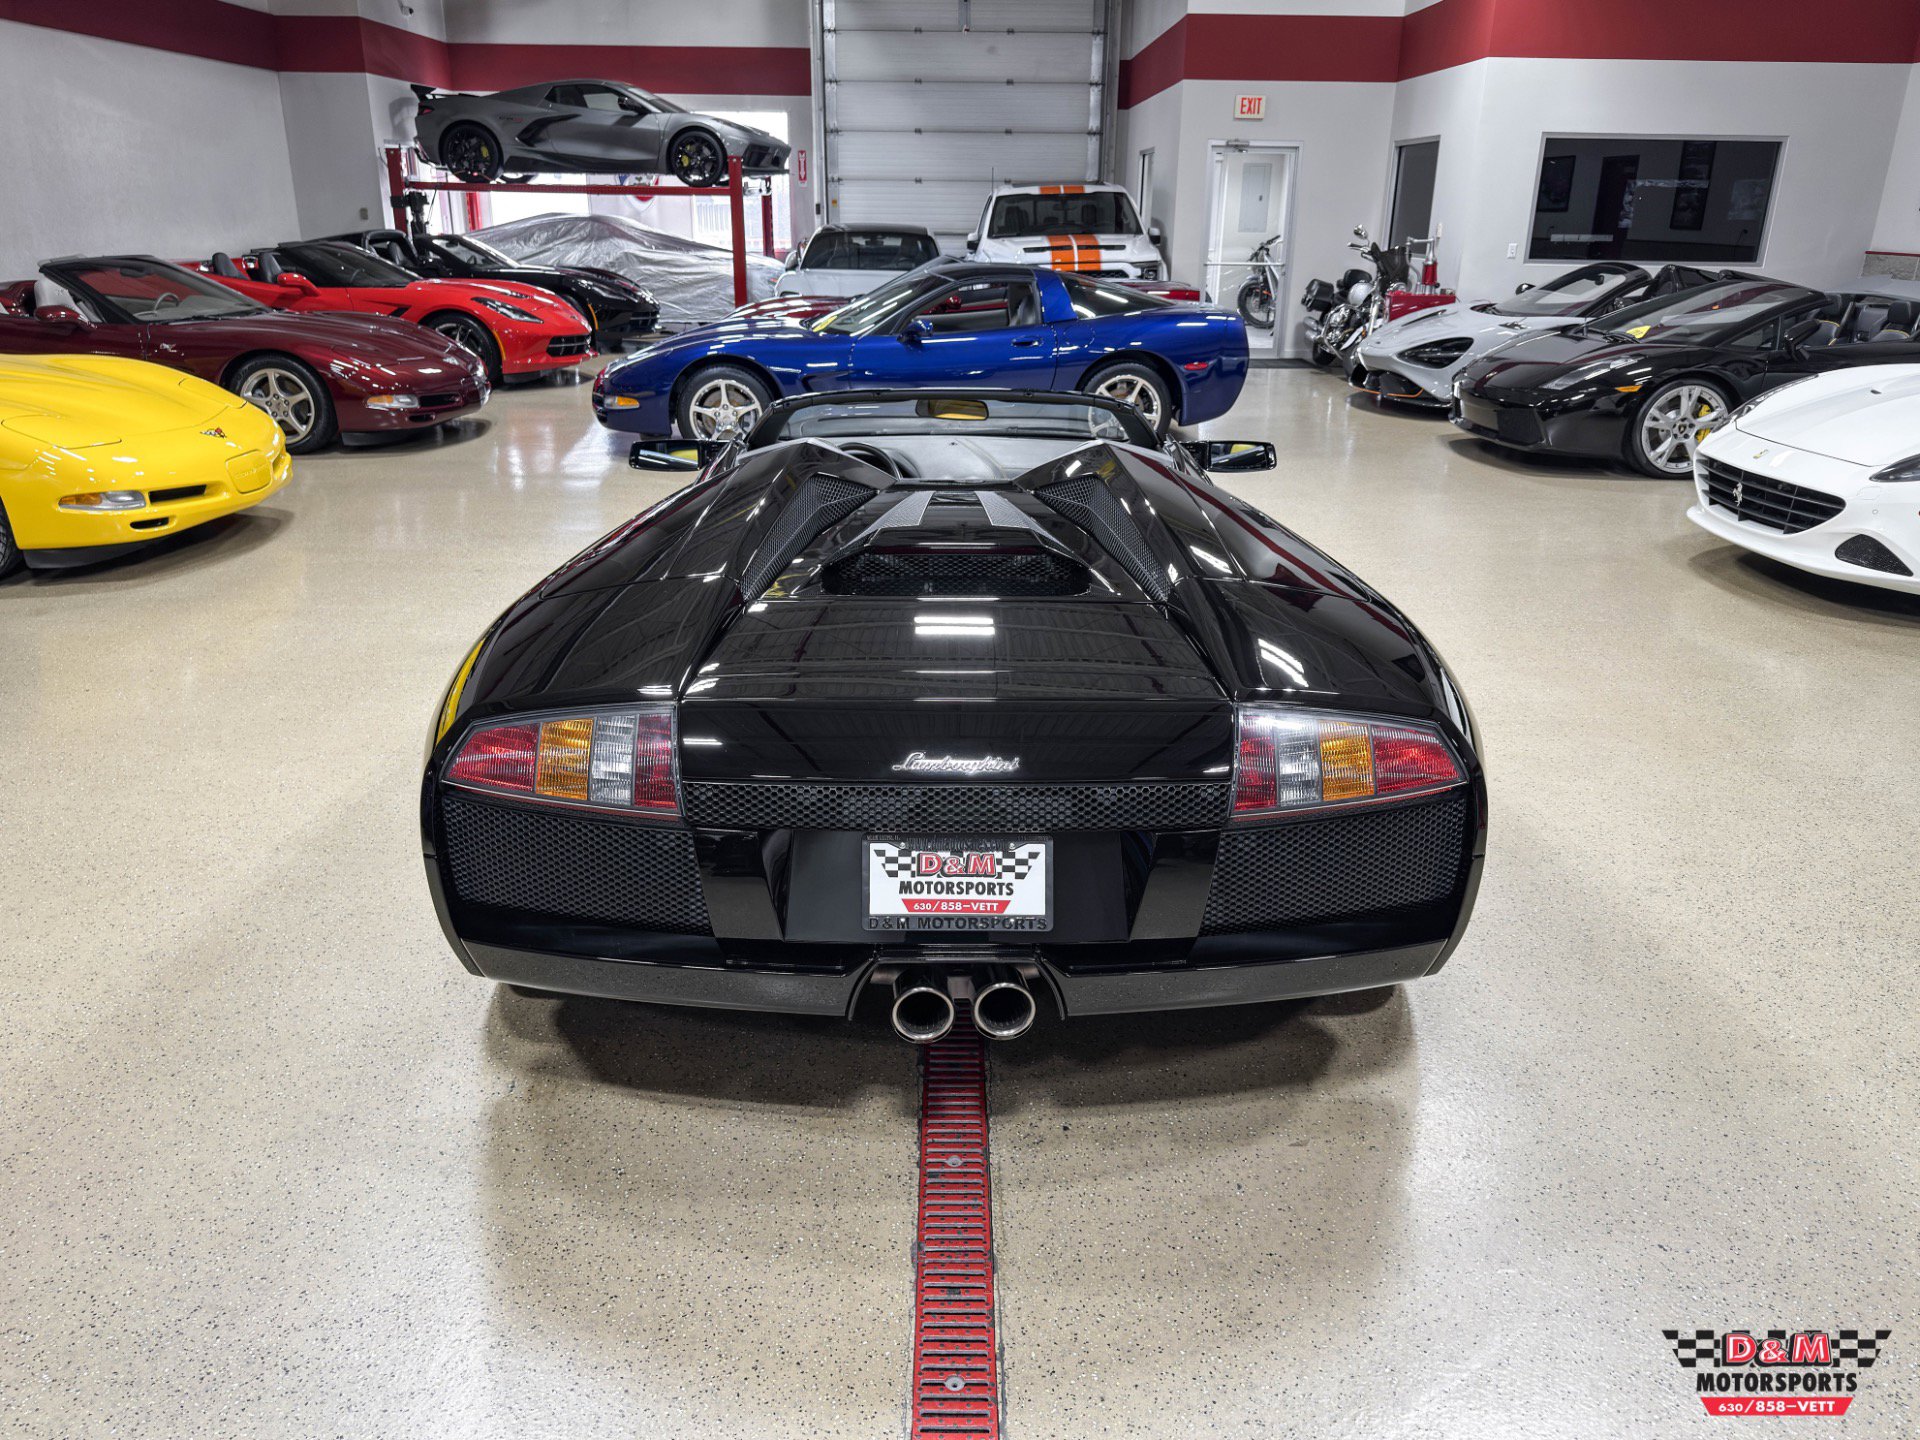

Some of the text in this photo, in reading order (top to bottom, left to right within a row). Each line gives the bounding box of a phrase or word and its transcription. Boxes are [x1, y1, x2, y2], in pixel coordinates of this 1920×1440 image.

[1240, 97, 1263, 115] EXIT
[892, 752, 1019, 776] Lamborghini
[917, 852, 996, 878] D&M
[899, 880, 1014, 896] MOTORSPORTS
[917, 916, 1048, 931] MOTORSPORTS
